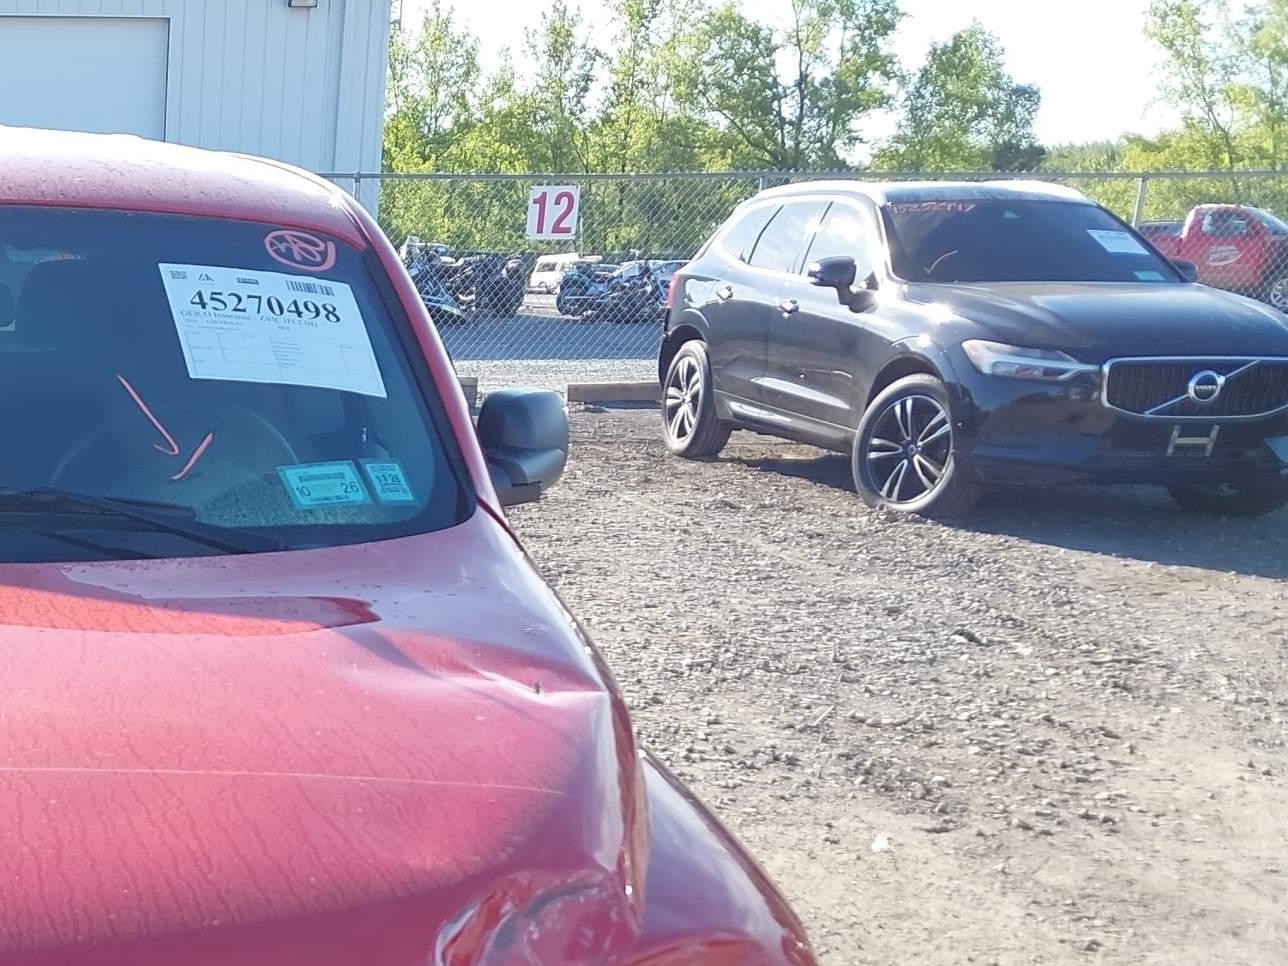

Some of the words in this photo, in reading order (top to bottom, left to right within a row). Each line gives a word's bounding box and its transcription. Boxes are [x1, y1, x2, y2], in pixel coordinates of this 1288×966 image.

[532, 191, 575, 234] 12
[189, 289, 342, 324] 45270498
[296, 485, 312, 497] 10
[340, 480, 360, 494] 26
